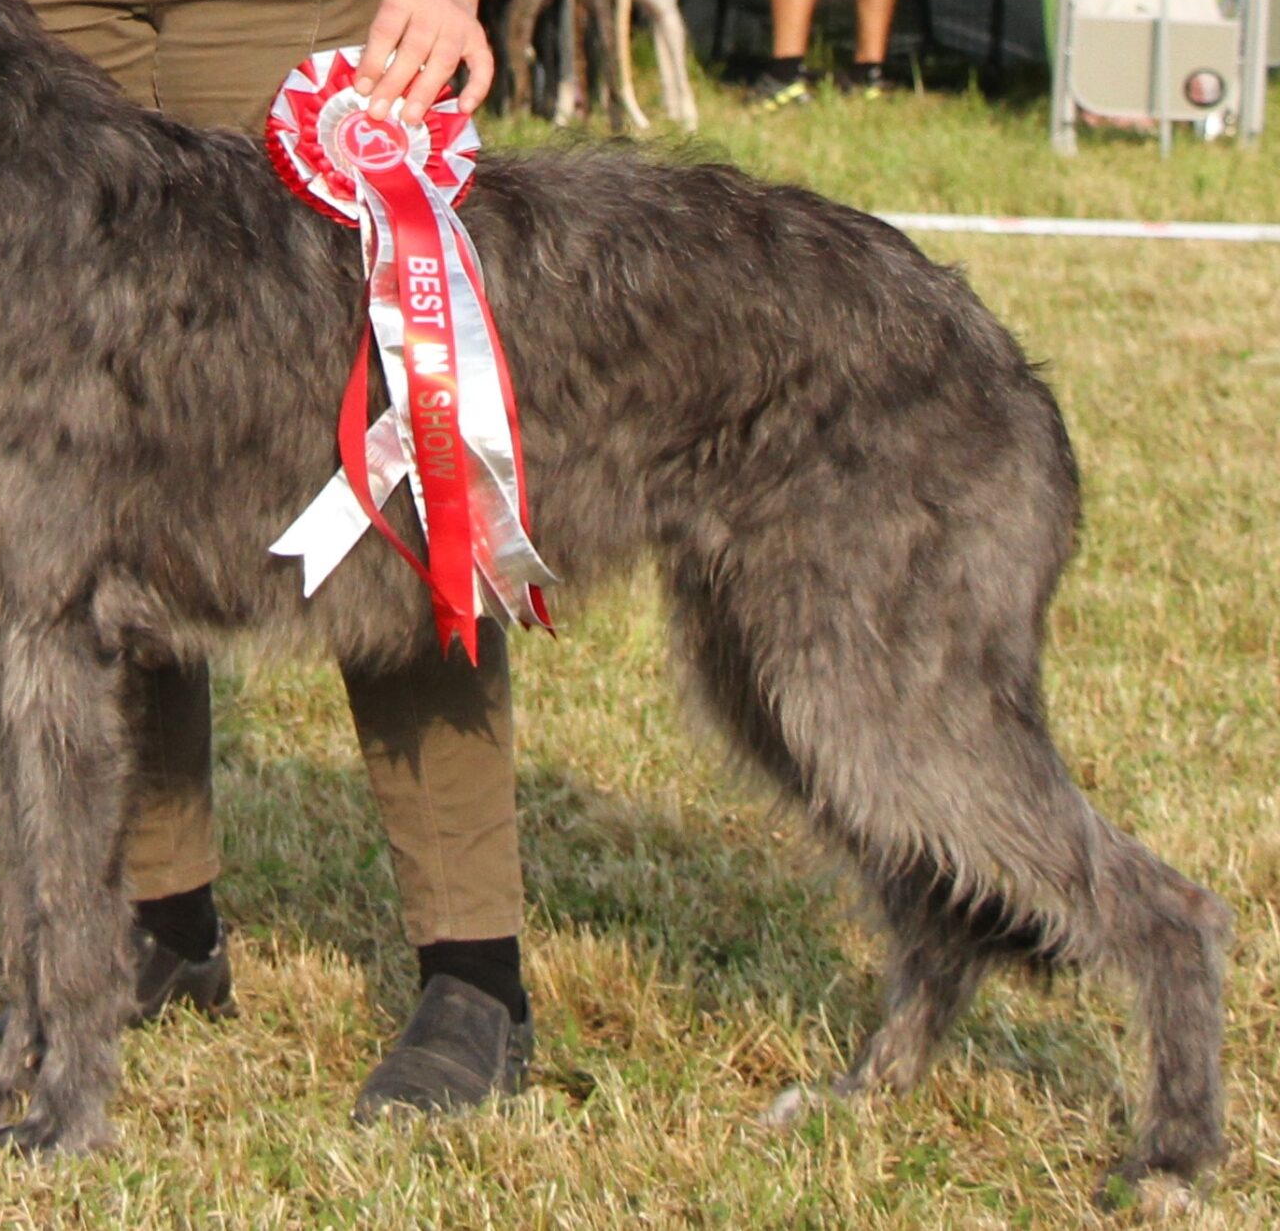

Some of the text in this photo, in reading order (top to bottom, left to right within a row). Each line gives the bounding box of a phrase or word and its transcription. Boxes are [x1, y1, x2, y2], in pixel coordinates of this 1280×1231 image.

[408, 256, 445, 329] BEST
[413, 343, 449, 374] IN
[418, 390, 455, 480] SHOW
